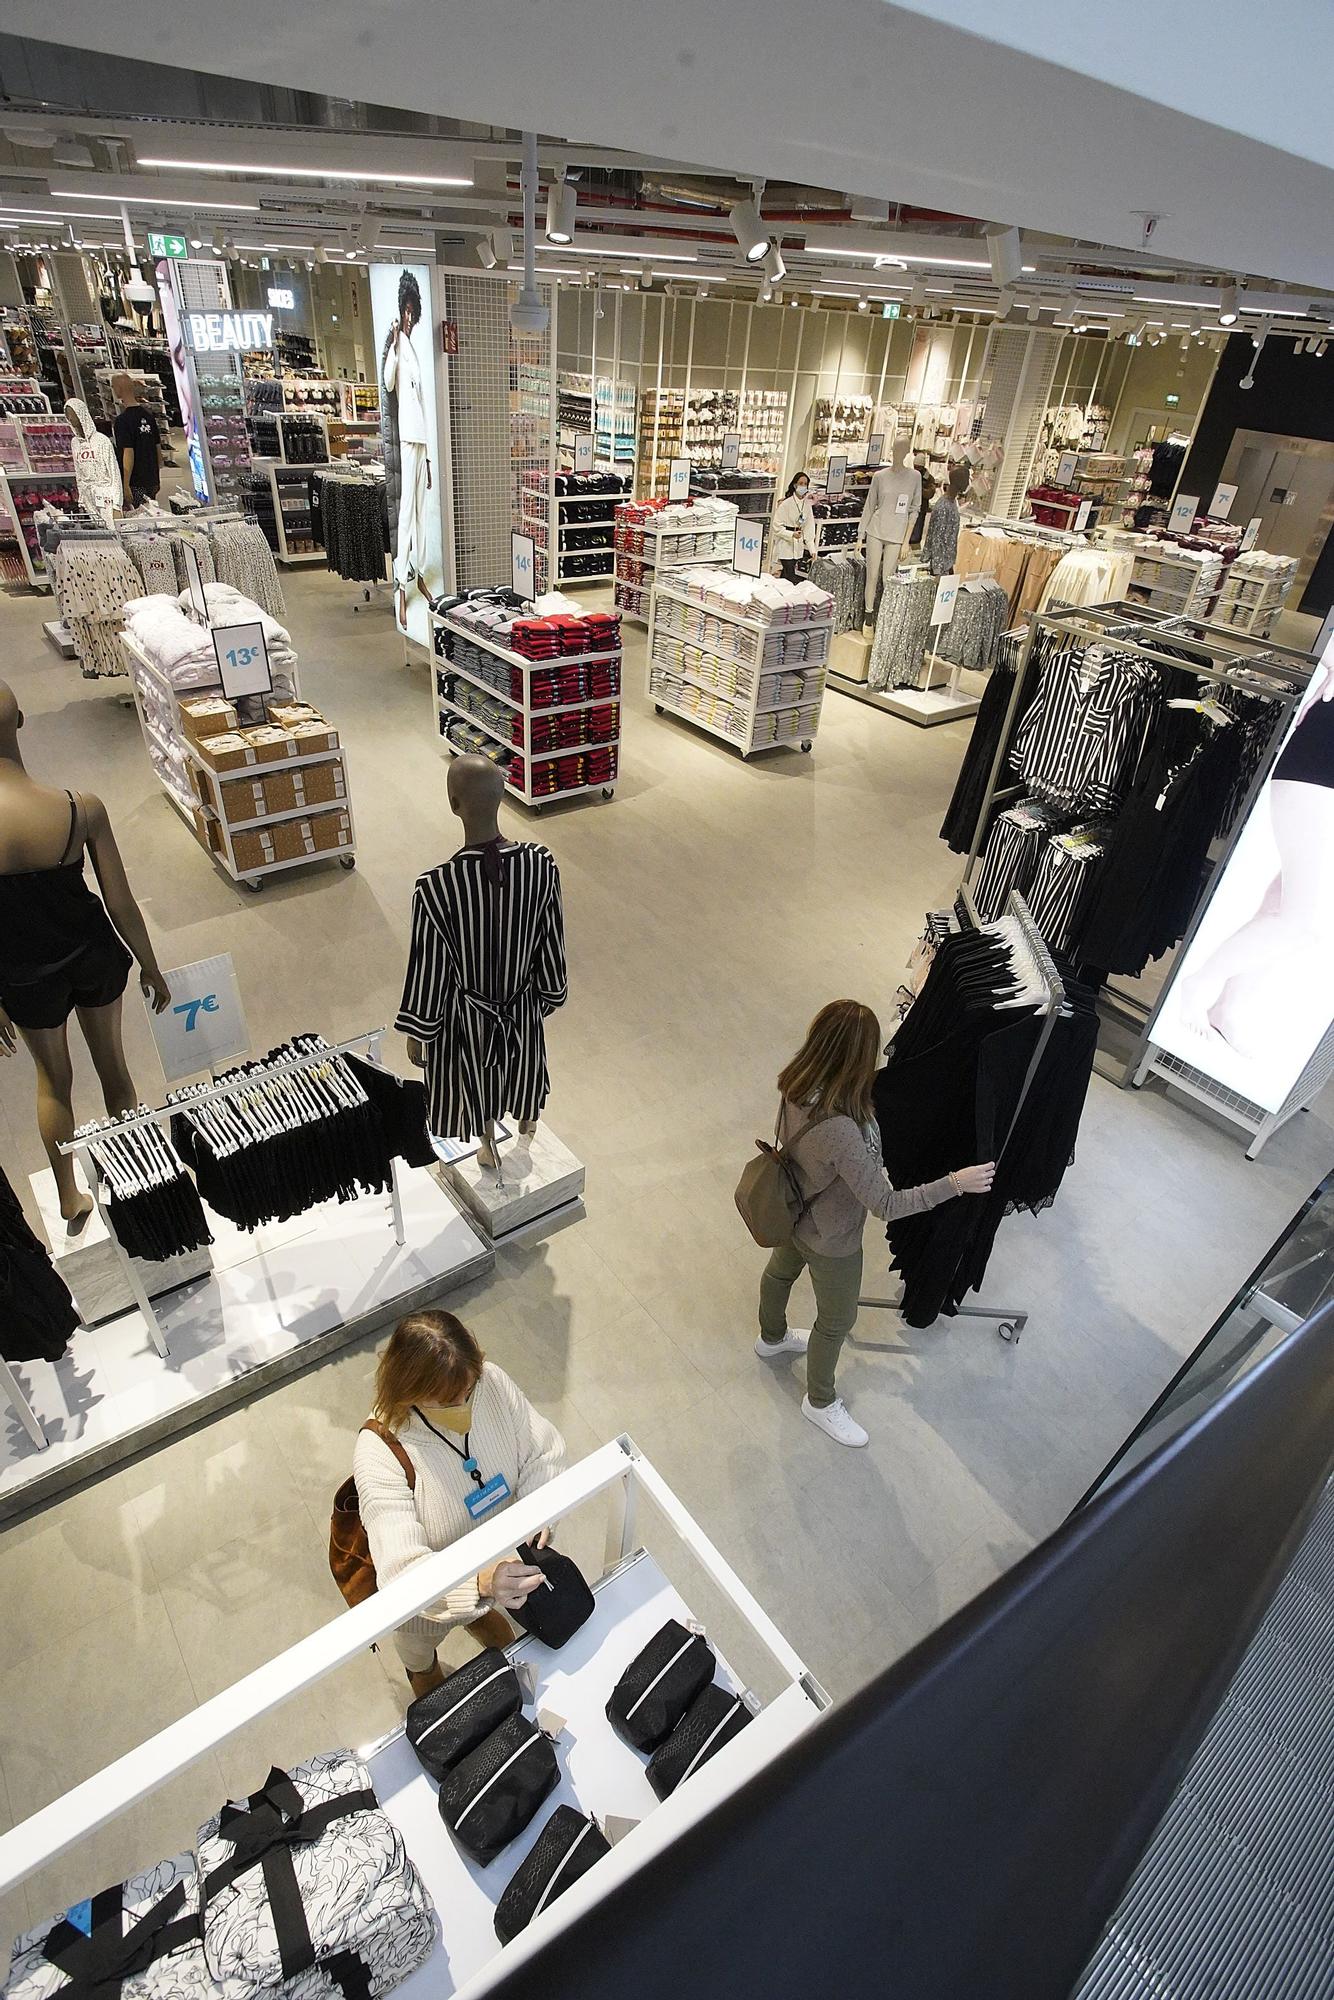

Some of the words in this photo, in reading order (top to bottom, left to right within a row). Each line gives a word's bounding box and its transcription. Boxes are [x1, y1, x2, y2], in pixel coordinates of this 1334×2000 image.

[190, 313, 273, 351] BEAUTY
[578, 446, 591, 456] 13€
[673, 472, 688, 482] 15€
[1176, 507, 1194, 517] 12€
[740, 537, 758, 551] 14€
[516, 554, 531, 572] 14€
[940, 590, 955, 603] 12€
[226, 646, 259, 667] 13€
[173, 994, 219, 1032] 7€
